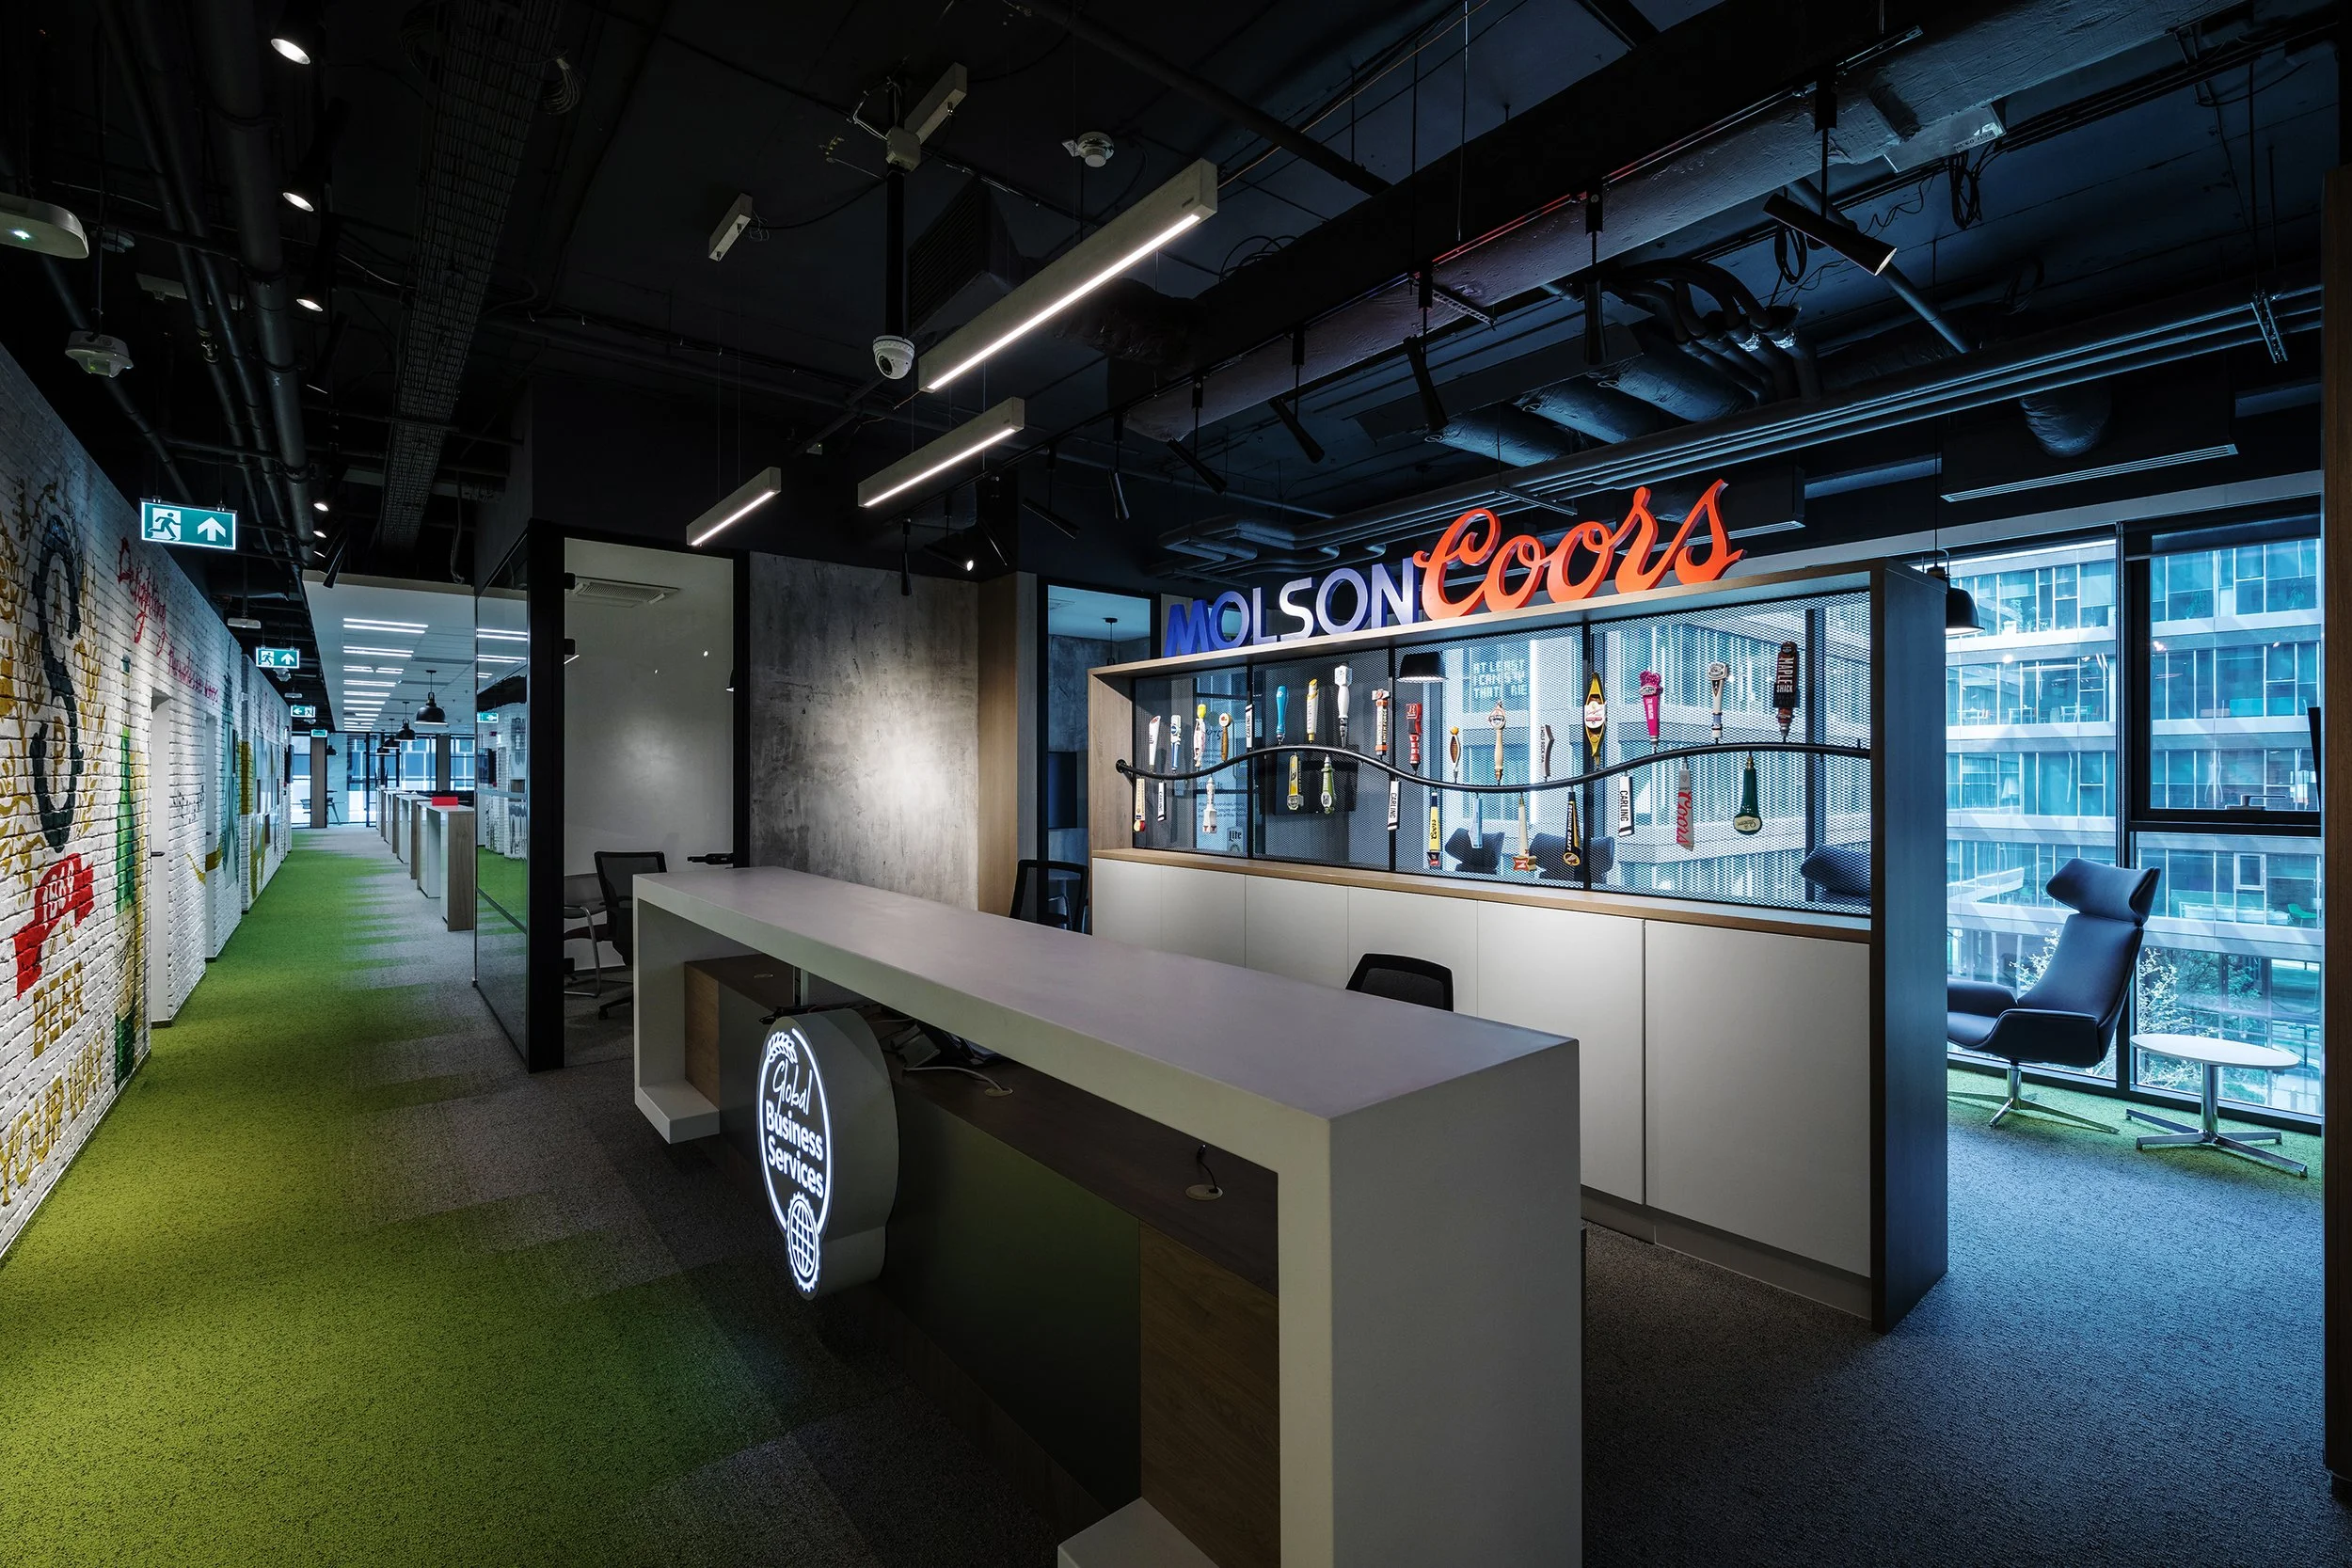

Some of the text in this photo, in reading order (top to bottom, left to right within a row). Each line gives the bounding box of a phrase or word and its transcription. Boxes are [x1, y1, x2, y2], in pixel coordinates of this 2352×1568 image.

[1165, 478, 1745, 658] MOLSON Coors
[1472, 658, 1525, 674] AT LEAST
[1478, 673, 1501, 686] CAN
[1504, 670, 1525, 684] SAY
[1777, 656, 1796, 687] MAPLE
[1473, 686, 1500, 699] THAT
[1776, 684, 1793, 693] SHACK
[1619, 790, 1629, 822] CARLING
[1676, 790, 1692, 846] Coors
[1228, 830, 1242, 842] Lite
[33, 959, 85, 1059] BEER
[771, 1058, 813, 1116] Global
[0, 1026, 105, 1207] YOUR WAY
[765, 1099, 824, 1162] Business
[767, 1134, 824, 1199] Services
